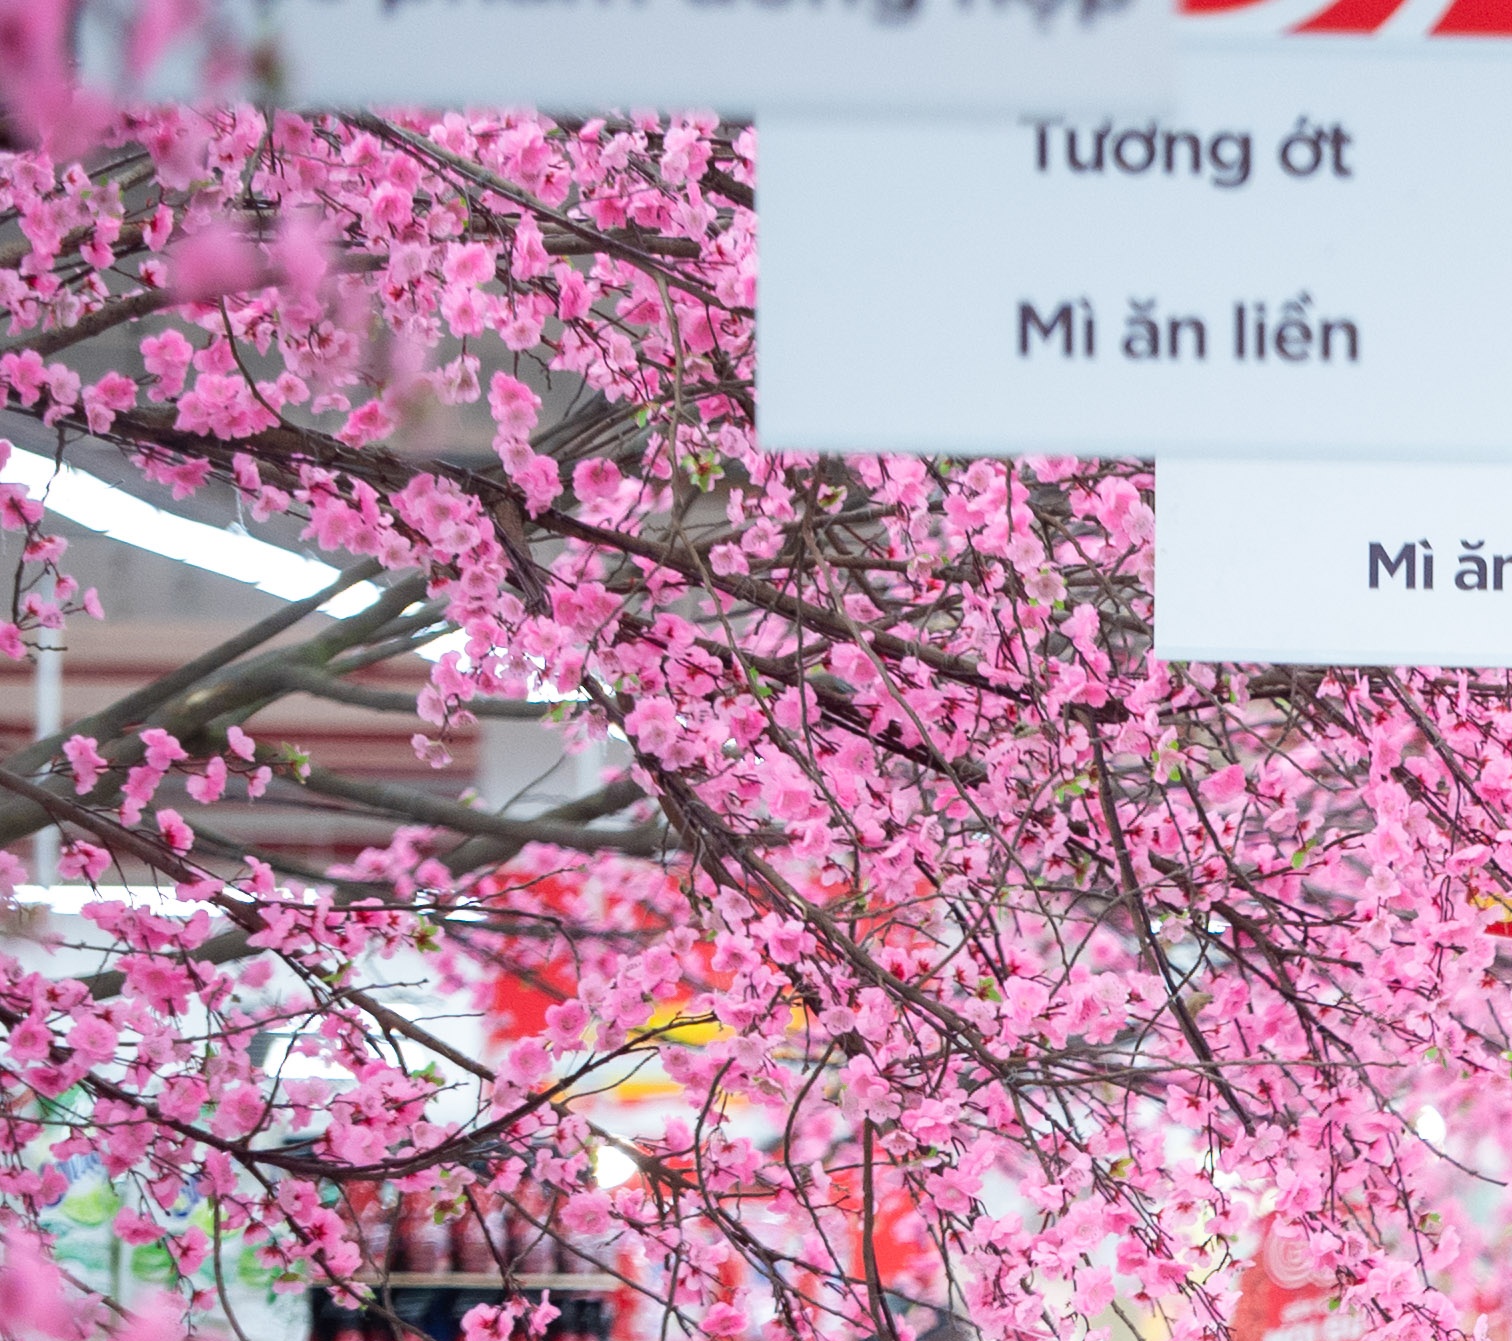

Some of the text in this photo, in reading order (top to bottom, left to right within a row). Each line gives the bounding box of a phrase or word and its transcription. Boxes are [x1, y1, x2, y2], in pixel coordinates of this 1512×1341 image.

[1024, 115, 1353, 188] Tương ớt
[1016, 290, 1362, 363] Mì ăn liền
[1368, 539, 1434, 590] Mì
